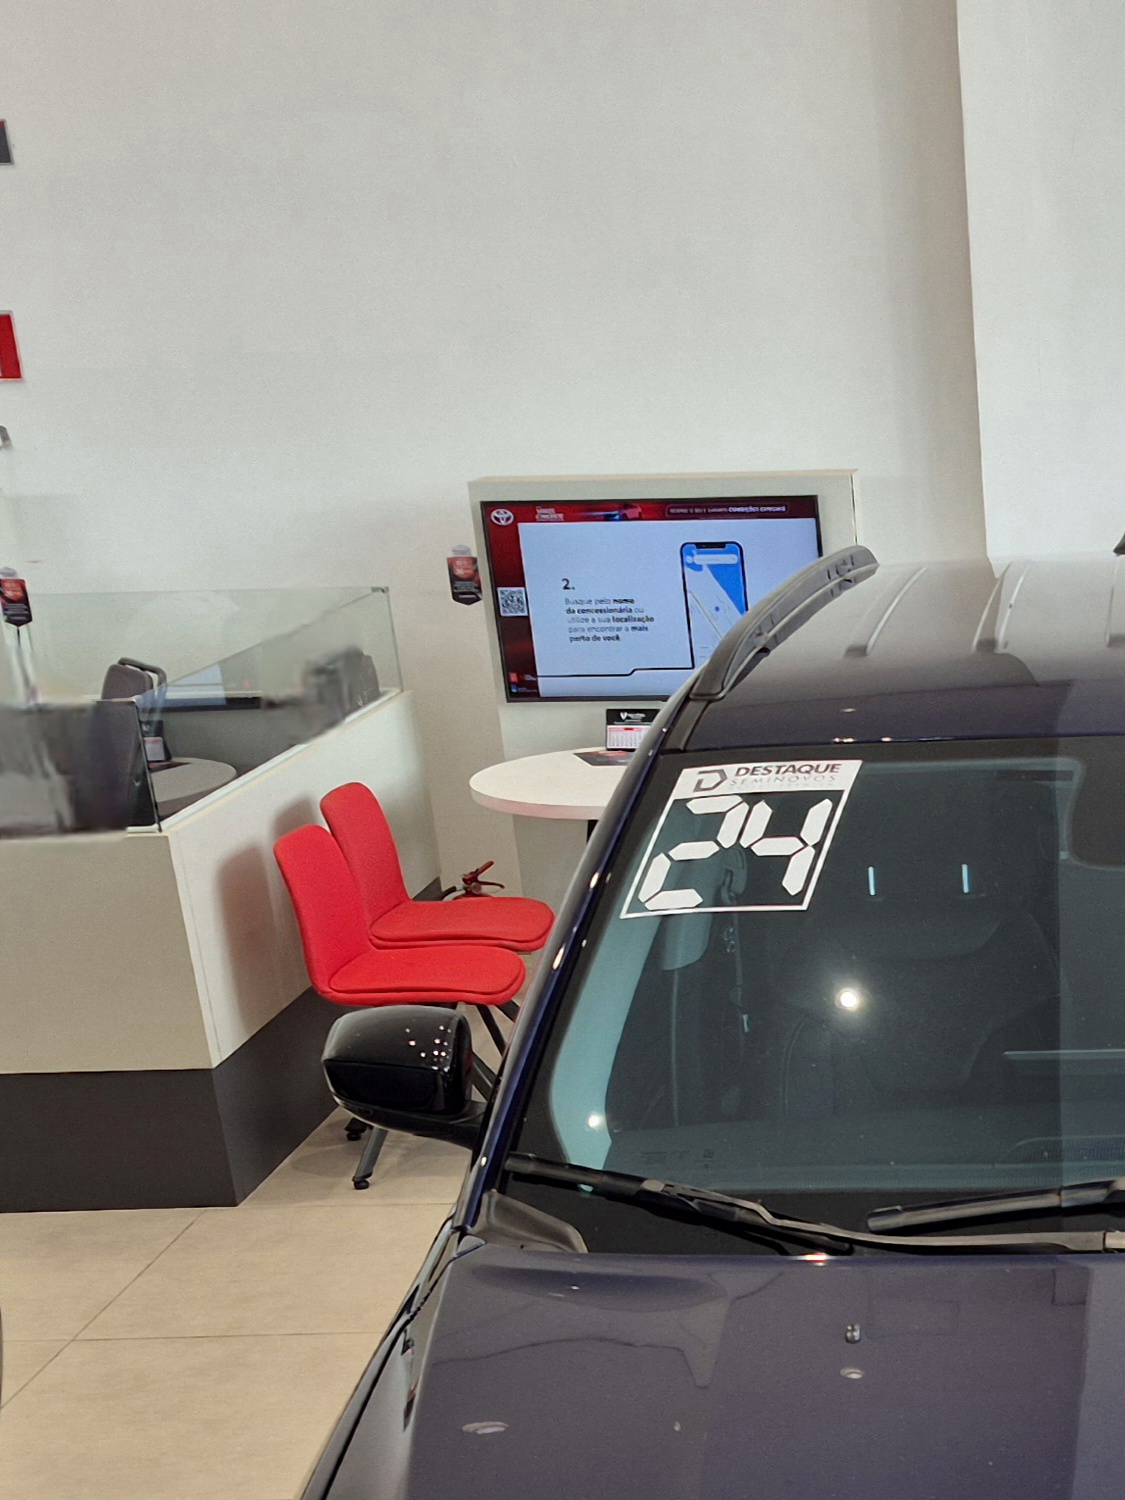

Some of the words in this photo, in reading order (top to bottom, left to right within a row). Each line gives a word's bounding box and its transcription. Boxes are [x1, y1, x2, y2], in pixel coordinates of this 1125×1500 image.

[561, 578, 575, 590] 2.
[565, 598, 592, 606] Busque
[735, 763, 842, 777] DESTAQUE
[730, 774, 837, 786] SEMINOVOS
[638, 794, 833, 910] 24
